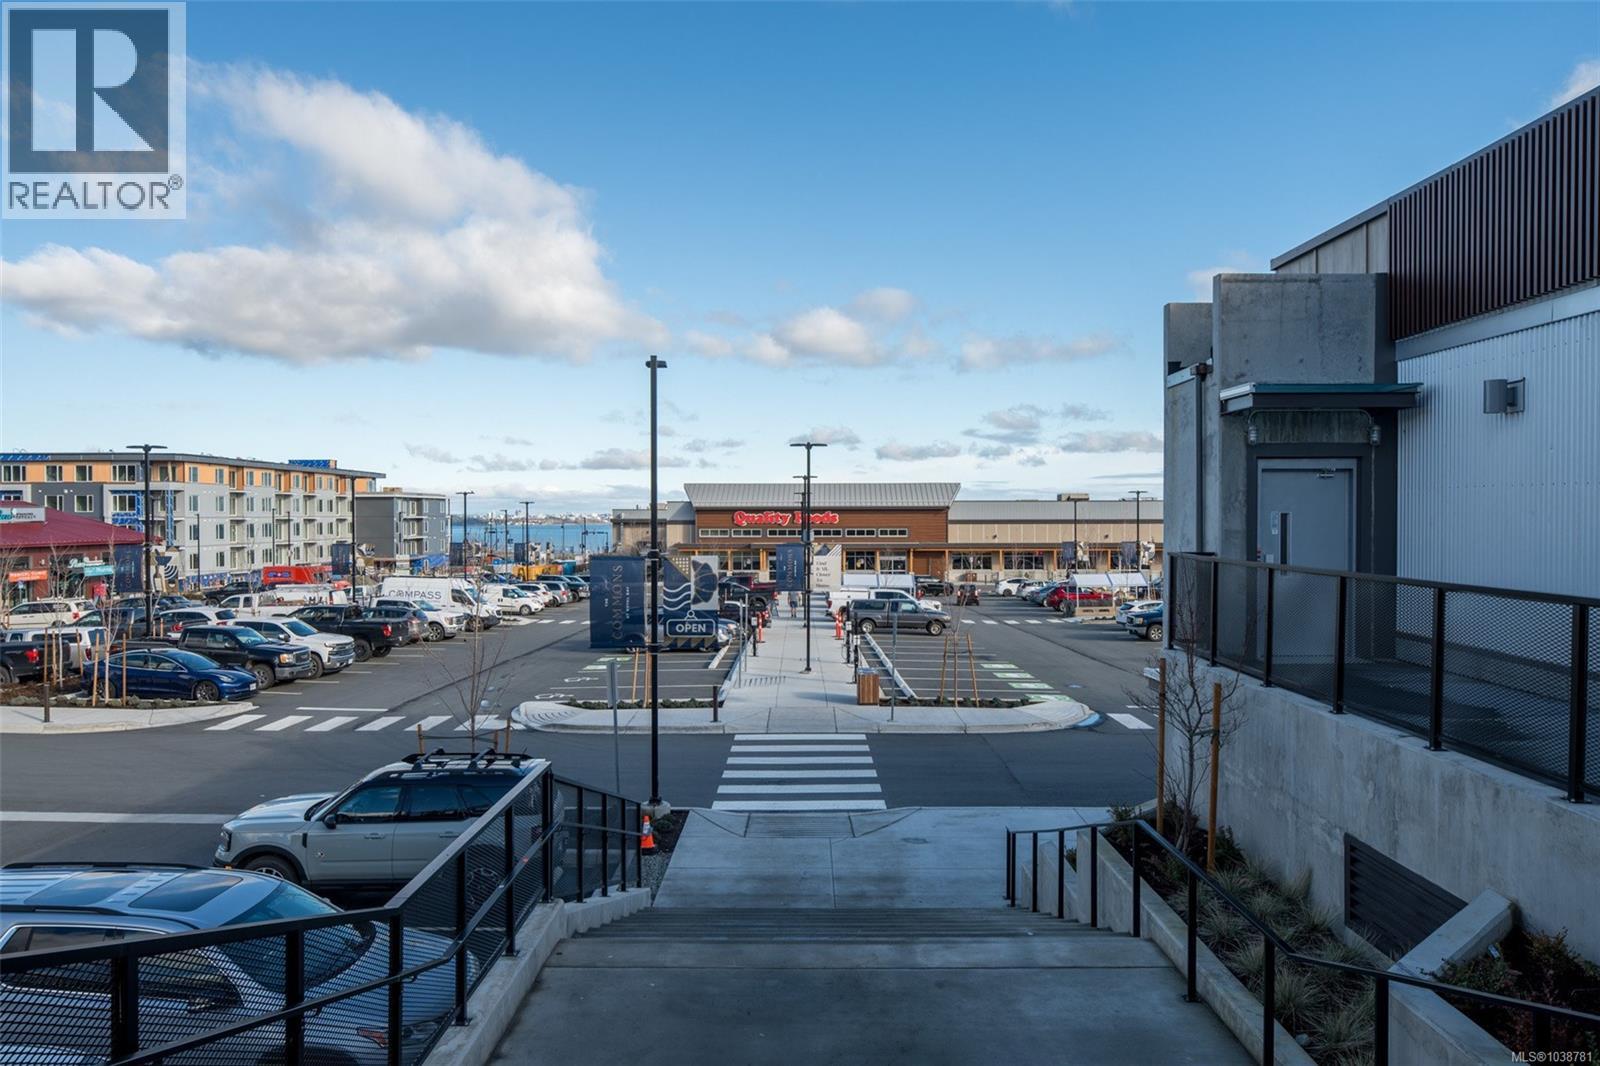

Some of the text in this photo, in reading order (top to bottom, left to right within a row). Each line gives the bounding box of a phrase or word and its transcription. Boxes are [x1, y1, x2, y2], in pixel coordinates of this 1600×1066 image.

[733, 511, 840, 526] Quality Fods
[389, 590, 442, 599] COMPASS
[612, 564, 624, 640] COMMONS
[675, 623, 706, 633] OPEN
